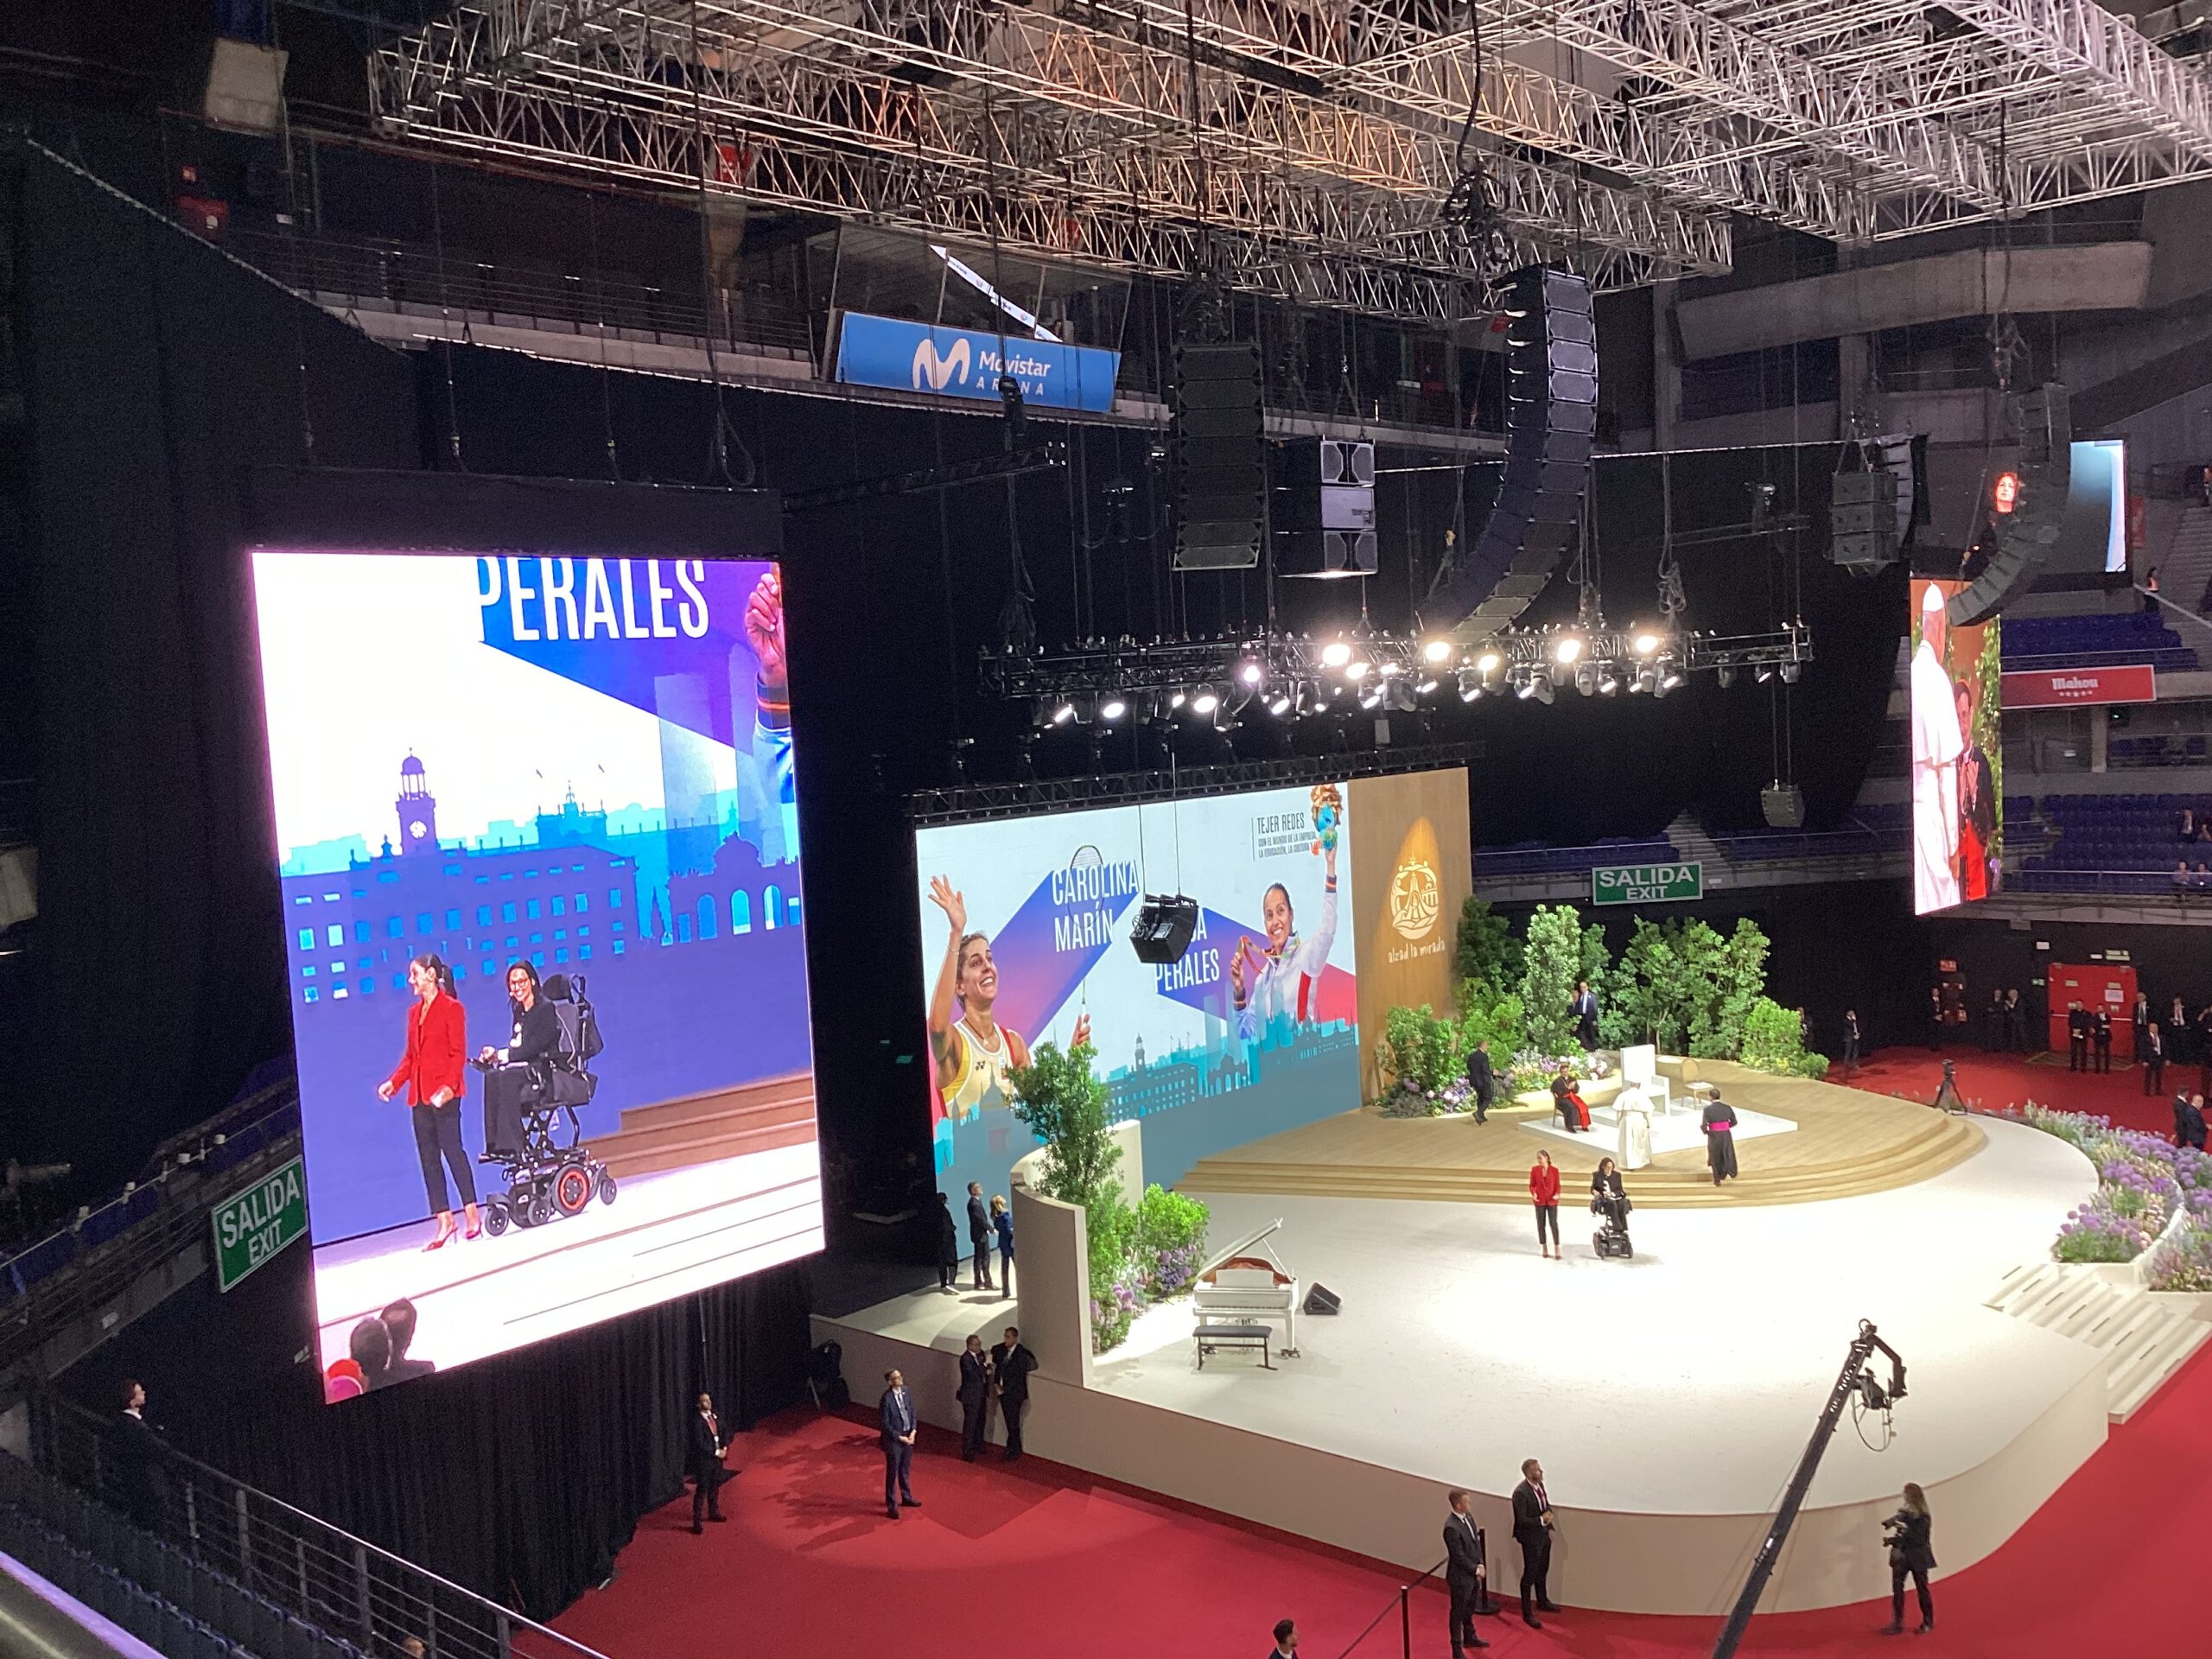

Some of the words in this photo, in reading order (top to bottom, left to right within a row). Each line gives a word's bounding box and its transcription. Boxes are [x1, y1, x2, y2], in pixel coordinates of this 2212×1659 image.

[979, 351, 1051, 377] Movistar
[976, 376, 1044, 396] ARNA
[470, 557, 709, 641] PERALES
[2051, 677, 2099, 690] Mahou
[1256, 815, 1280, 835] TEJER
[1281, 811, 1305, 831] REDES
[1052, 860, 1140, 906] CAROLINA
[1599, 867, 1694, 887] SALIDA
[1626, 886, 1668, 900] EXIT
[1054, 901, 1114, 952] MARÍN
[1388, 943, 1408, 963] alzad
[1410, 943, 1418, 959] la
[1420, 936, 1446, 957] mirada
[1154, 948, 1220, 994] PERALES
[221, 1169, 300, 1249] SALIDA
[248, 1218, 282, 1266] EXIT
